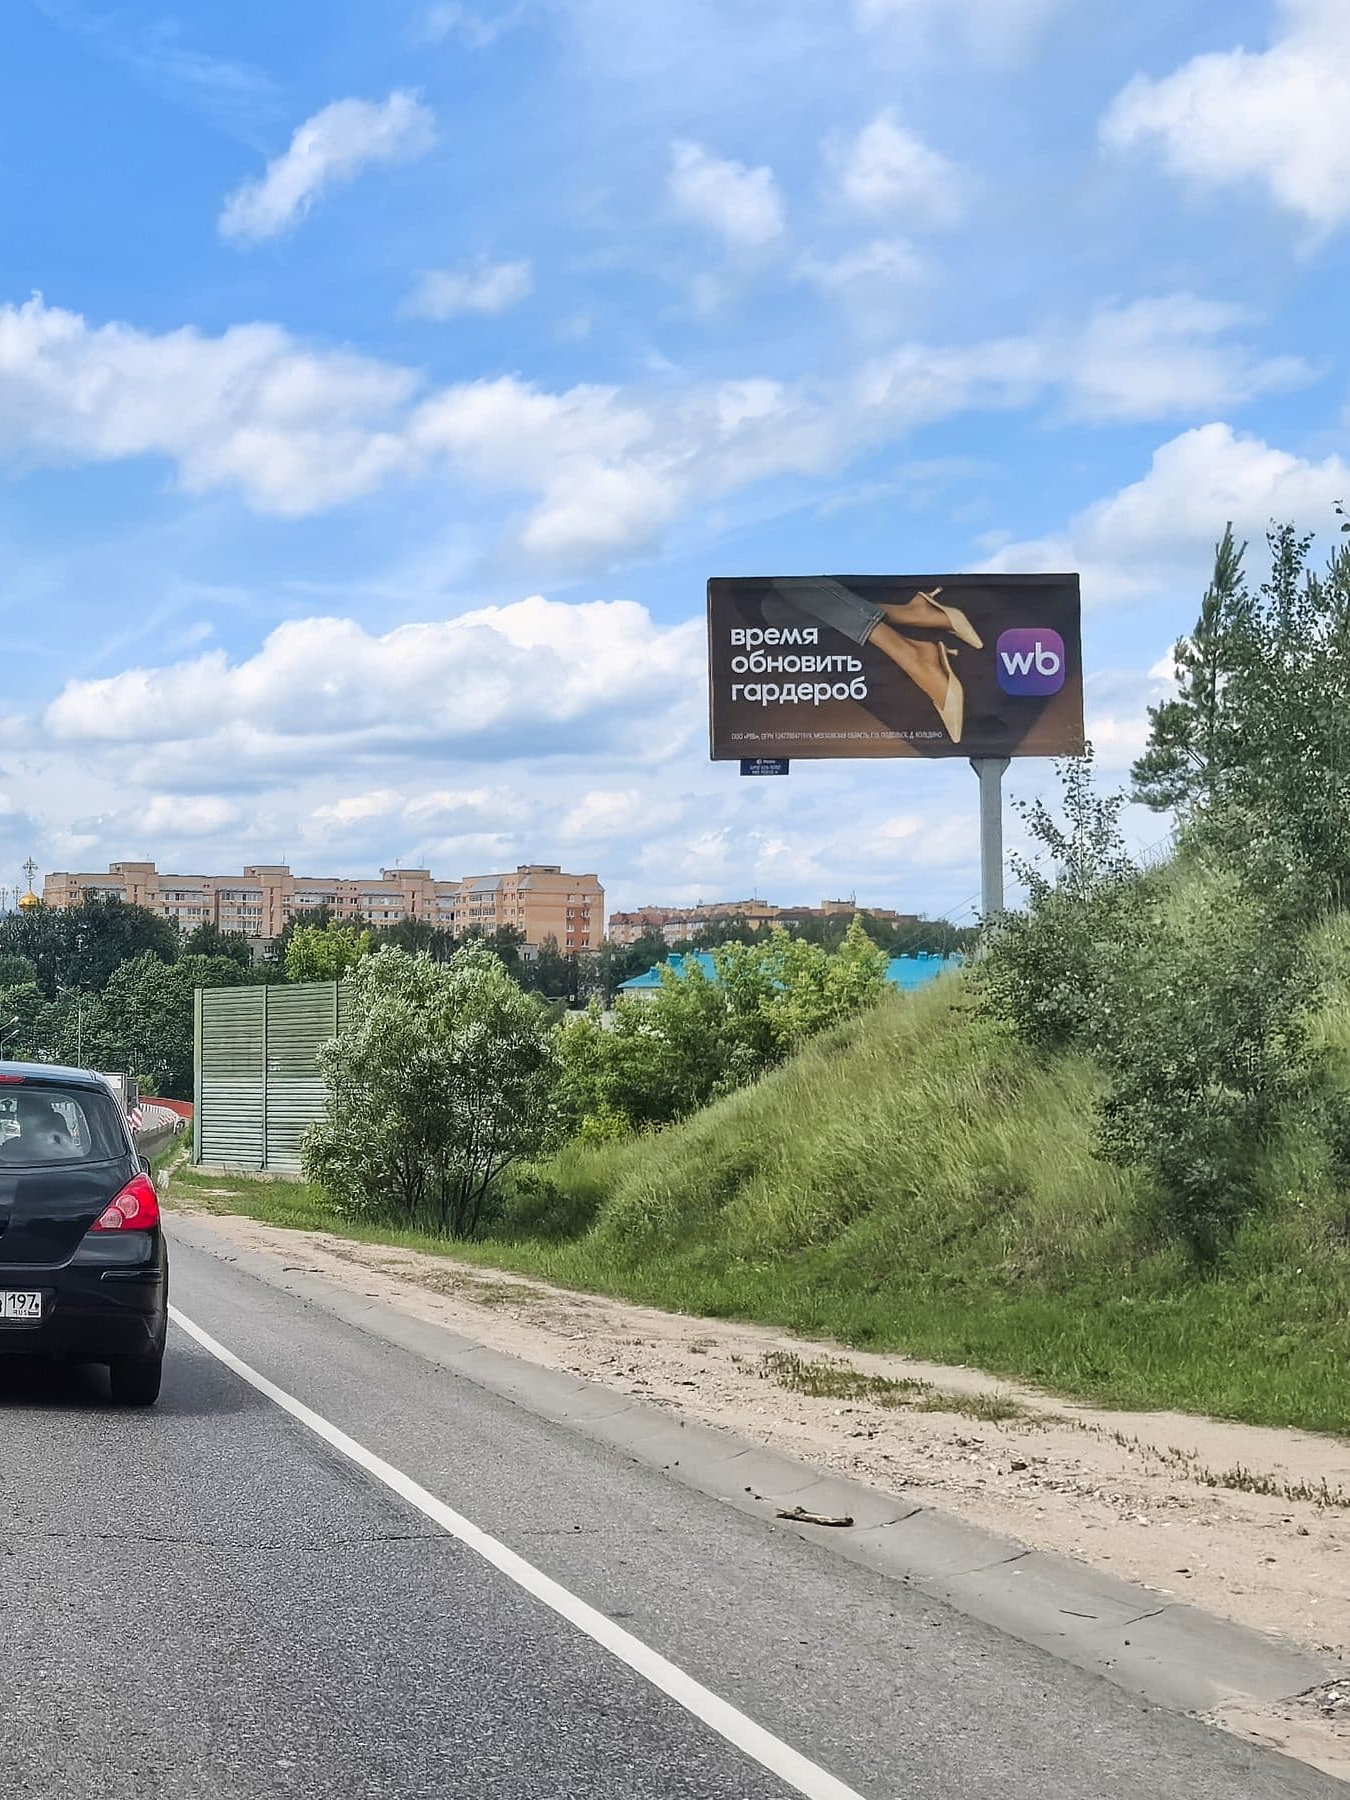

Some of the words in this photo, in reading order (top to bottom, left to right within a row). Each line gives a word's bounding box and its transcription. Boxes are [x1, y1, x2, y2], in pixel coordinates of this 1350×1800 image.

[731, 627, 818, 651] время
[731, 649, 862, 673] обновить
[1000, 642, 1060, 676] wb
[731, 676, 868, 706] гардероб
[8, 1294, 36, 1310] 197
